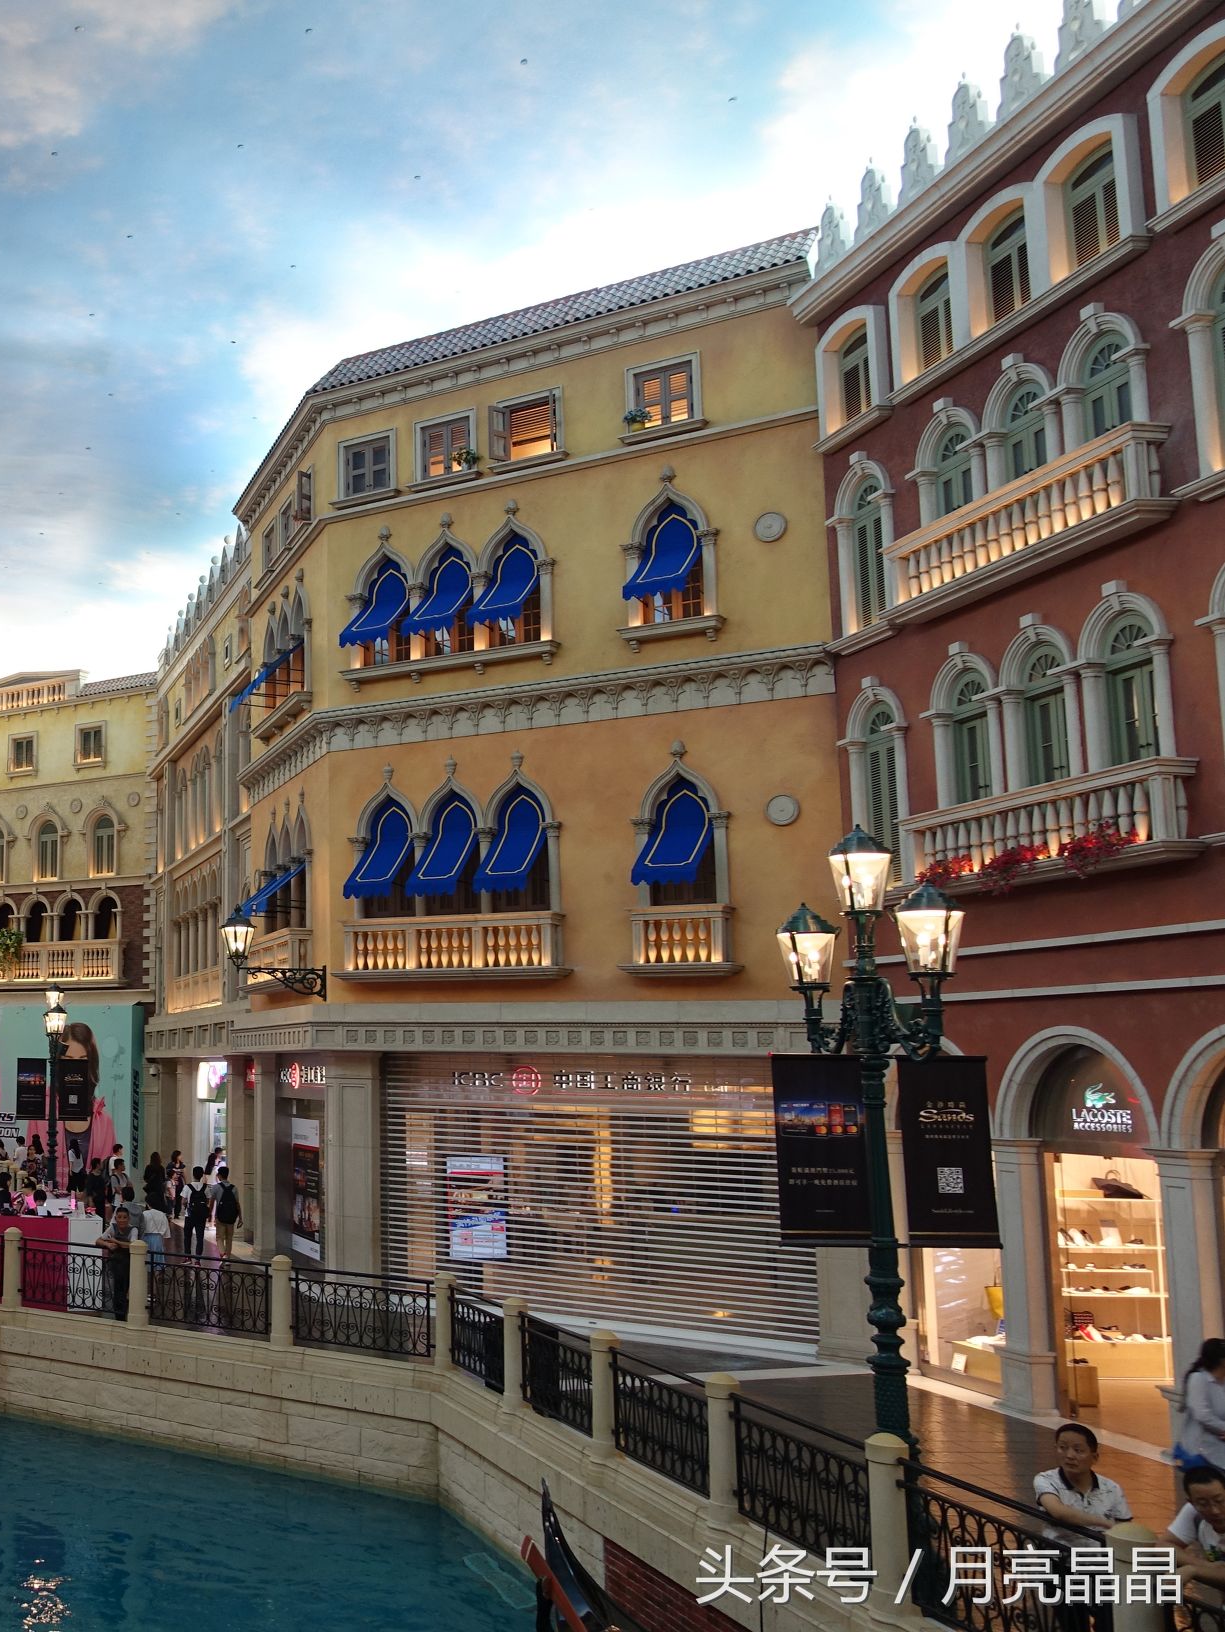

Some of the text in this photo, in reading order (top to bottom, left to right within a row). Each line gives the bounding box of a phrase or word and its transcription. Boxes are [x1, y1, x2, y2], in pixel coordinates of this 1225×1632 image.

[452, 1071, 504, 1088] ICBC
[918, 1108, 975, 1122] Sands
[1071, 1108, 1132, 1124] LACOSTE
[1073, 1122, 1133, 1133] ACCESSORIES
